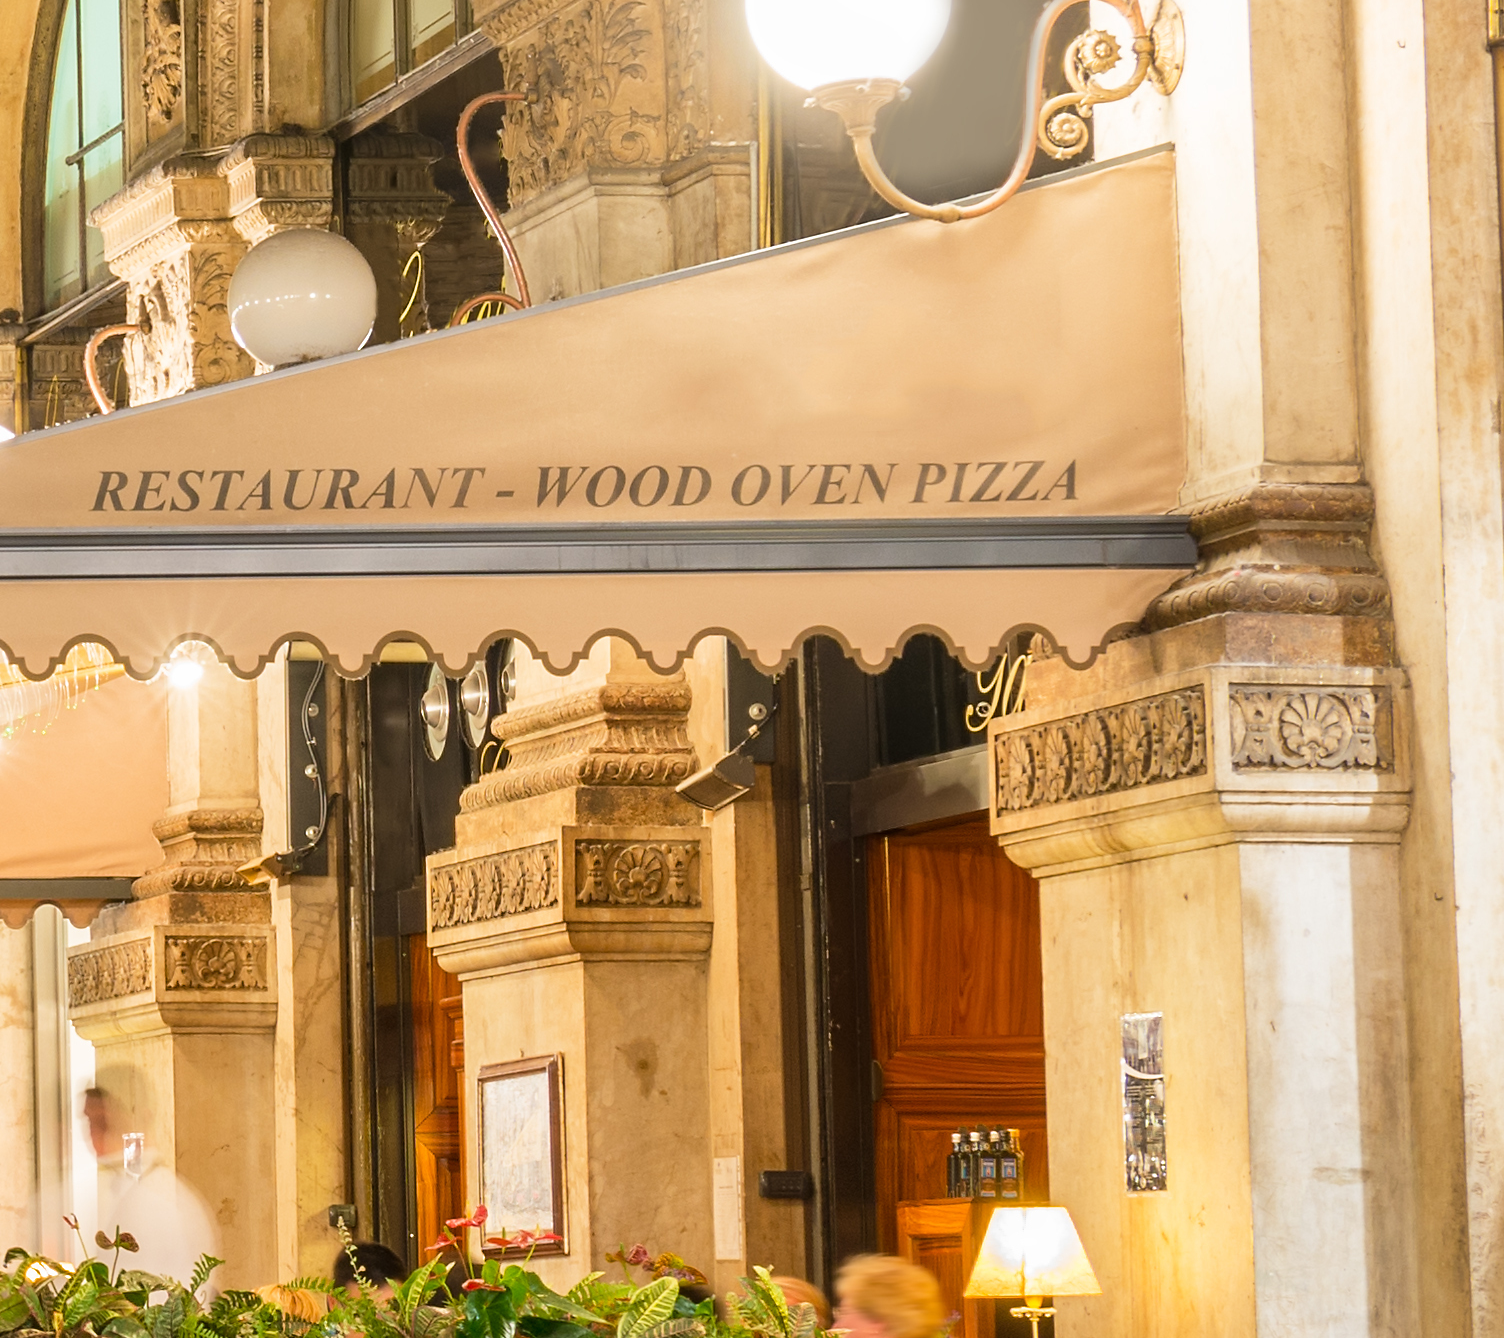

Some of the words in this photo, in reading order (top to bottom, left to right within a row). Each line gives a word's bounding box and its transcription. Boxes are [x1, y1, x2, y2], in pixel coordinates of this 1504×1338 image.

[89, 467, 486, 513] RESTAURANT
[535, 463, 713, 509] WOOD
[730, 461, 899, 508] OVEN
[909, 457, 1081, 505] PIZZA
